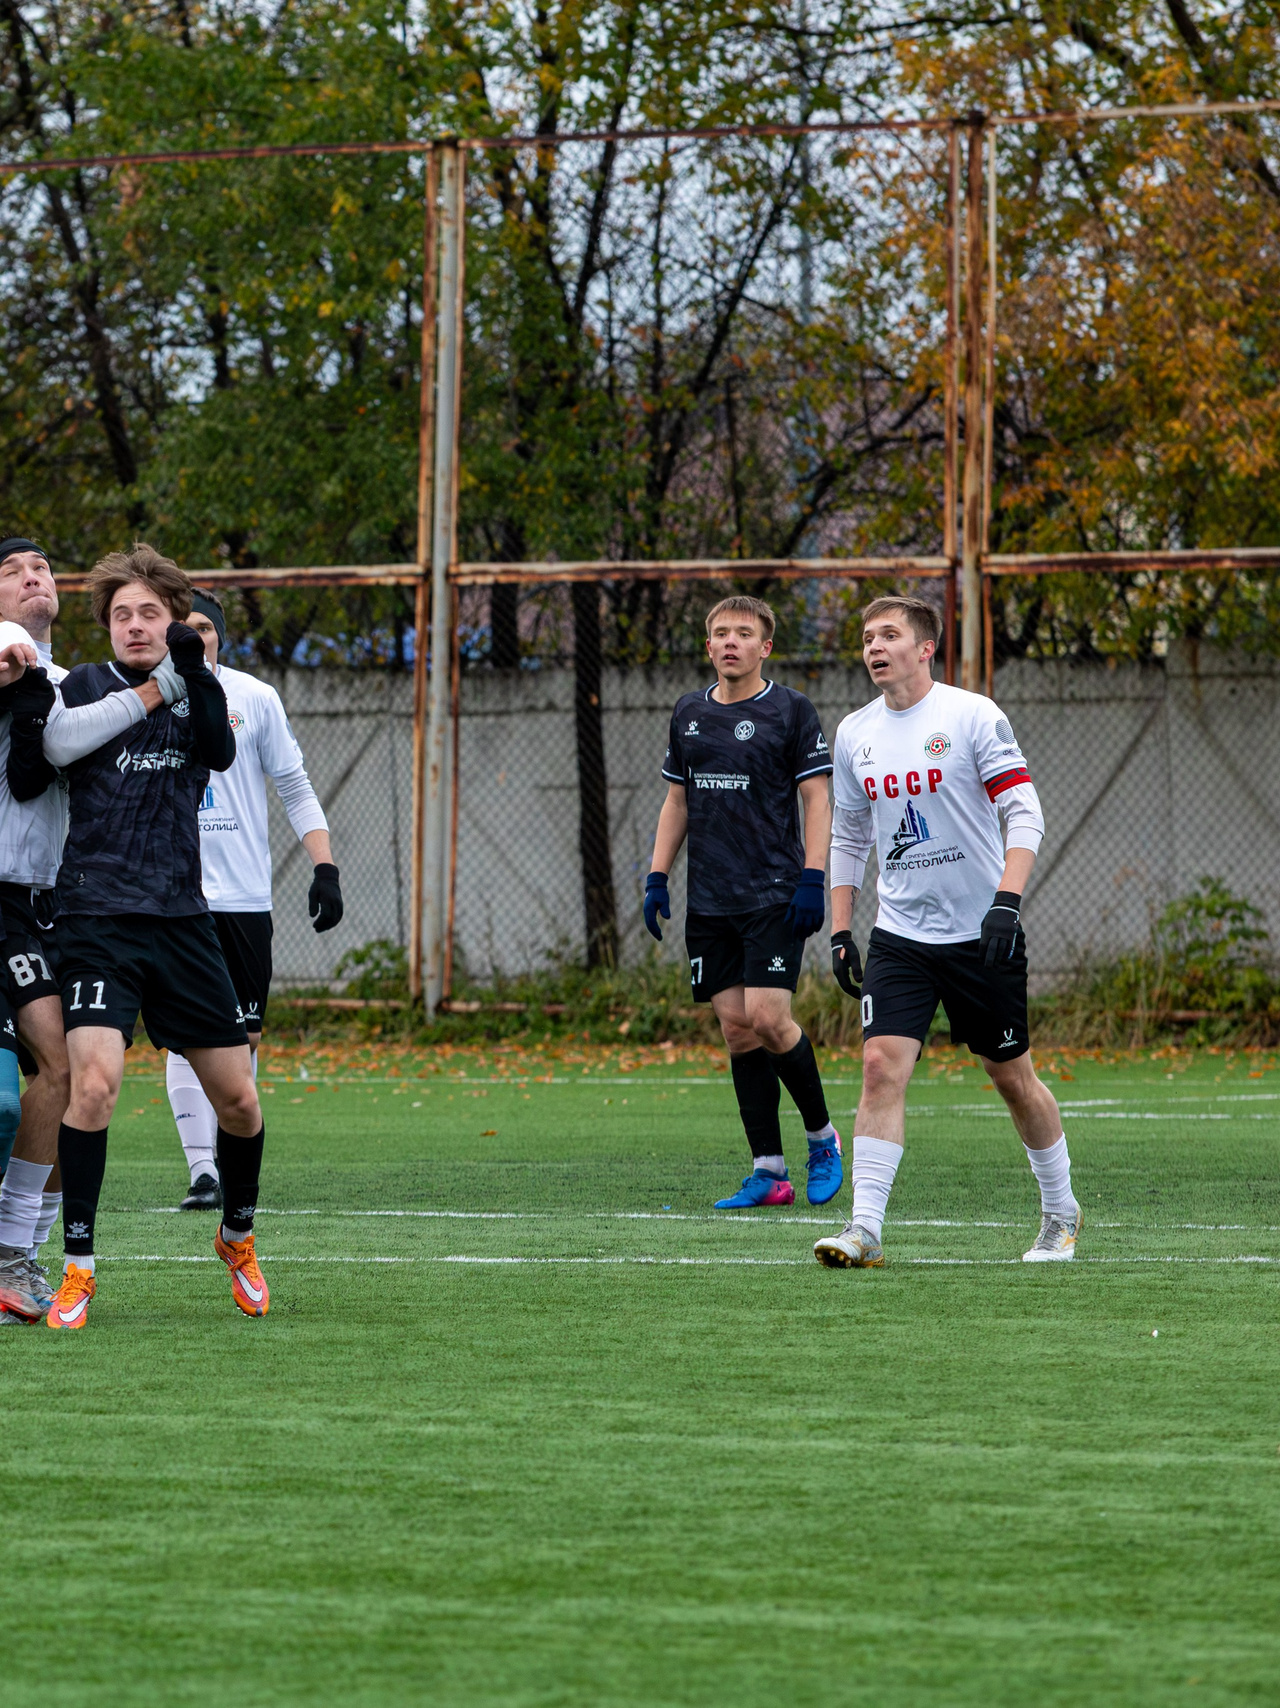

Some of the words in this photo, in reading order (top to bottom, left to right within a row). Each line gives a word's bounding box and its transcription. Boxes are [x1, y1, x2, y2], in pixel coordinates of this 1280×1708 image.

[694, 779, 750, 790] TATNEFT
[863, 768, 943, 801] СССР
[885, 851, 966, 871] АВТОСТОЛИЦА
[926, 844, 959, 857] КОМПАНИЙ
[7, 952, 52, 988] 87
[70, 980, 107, 1011] 11
